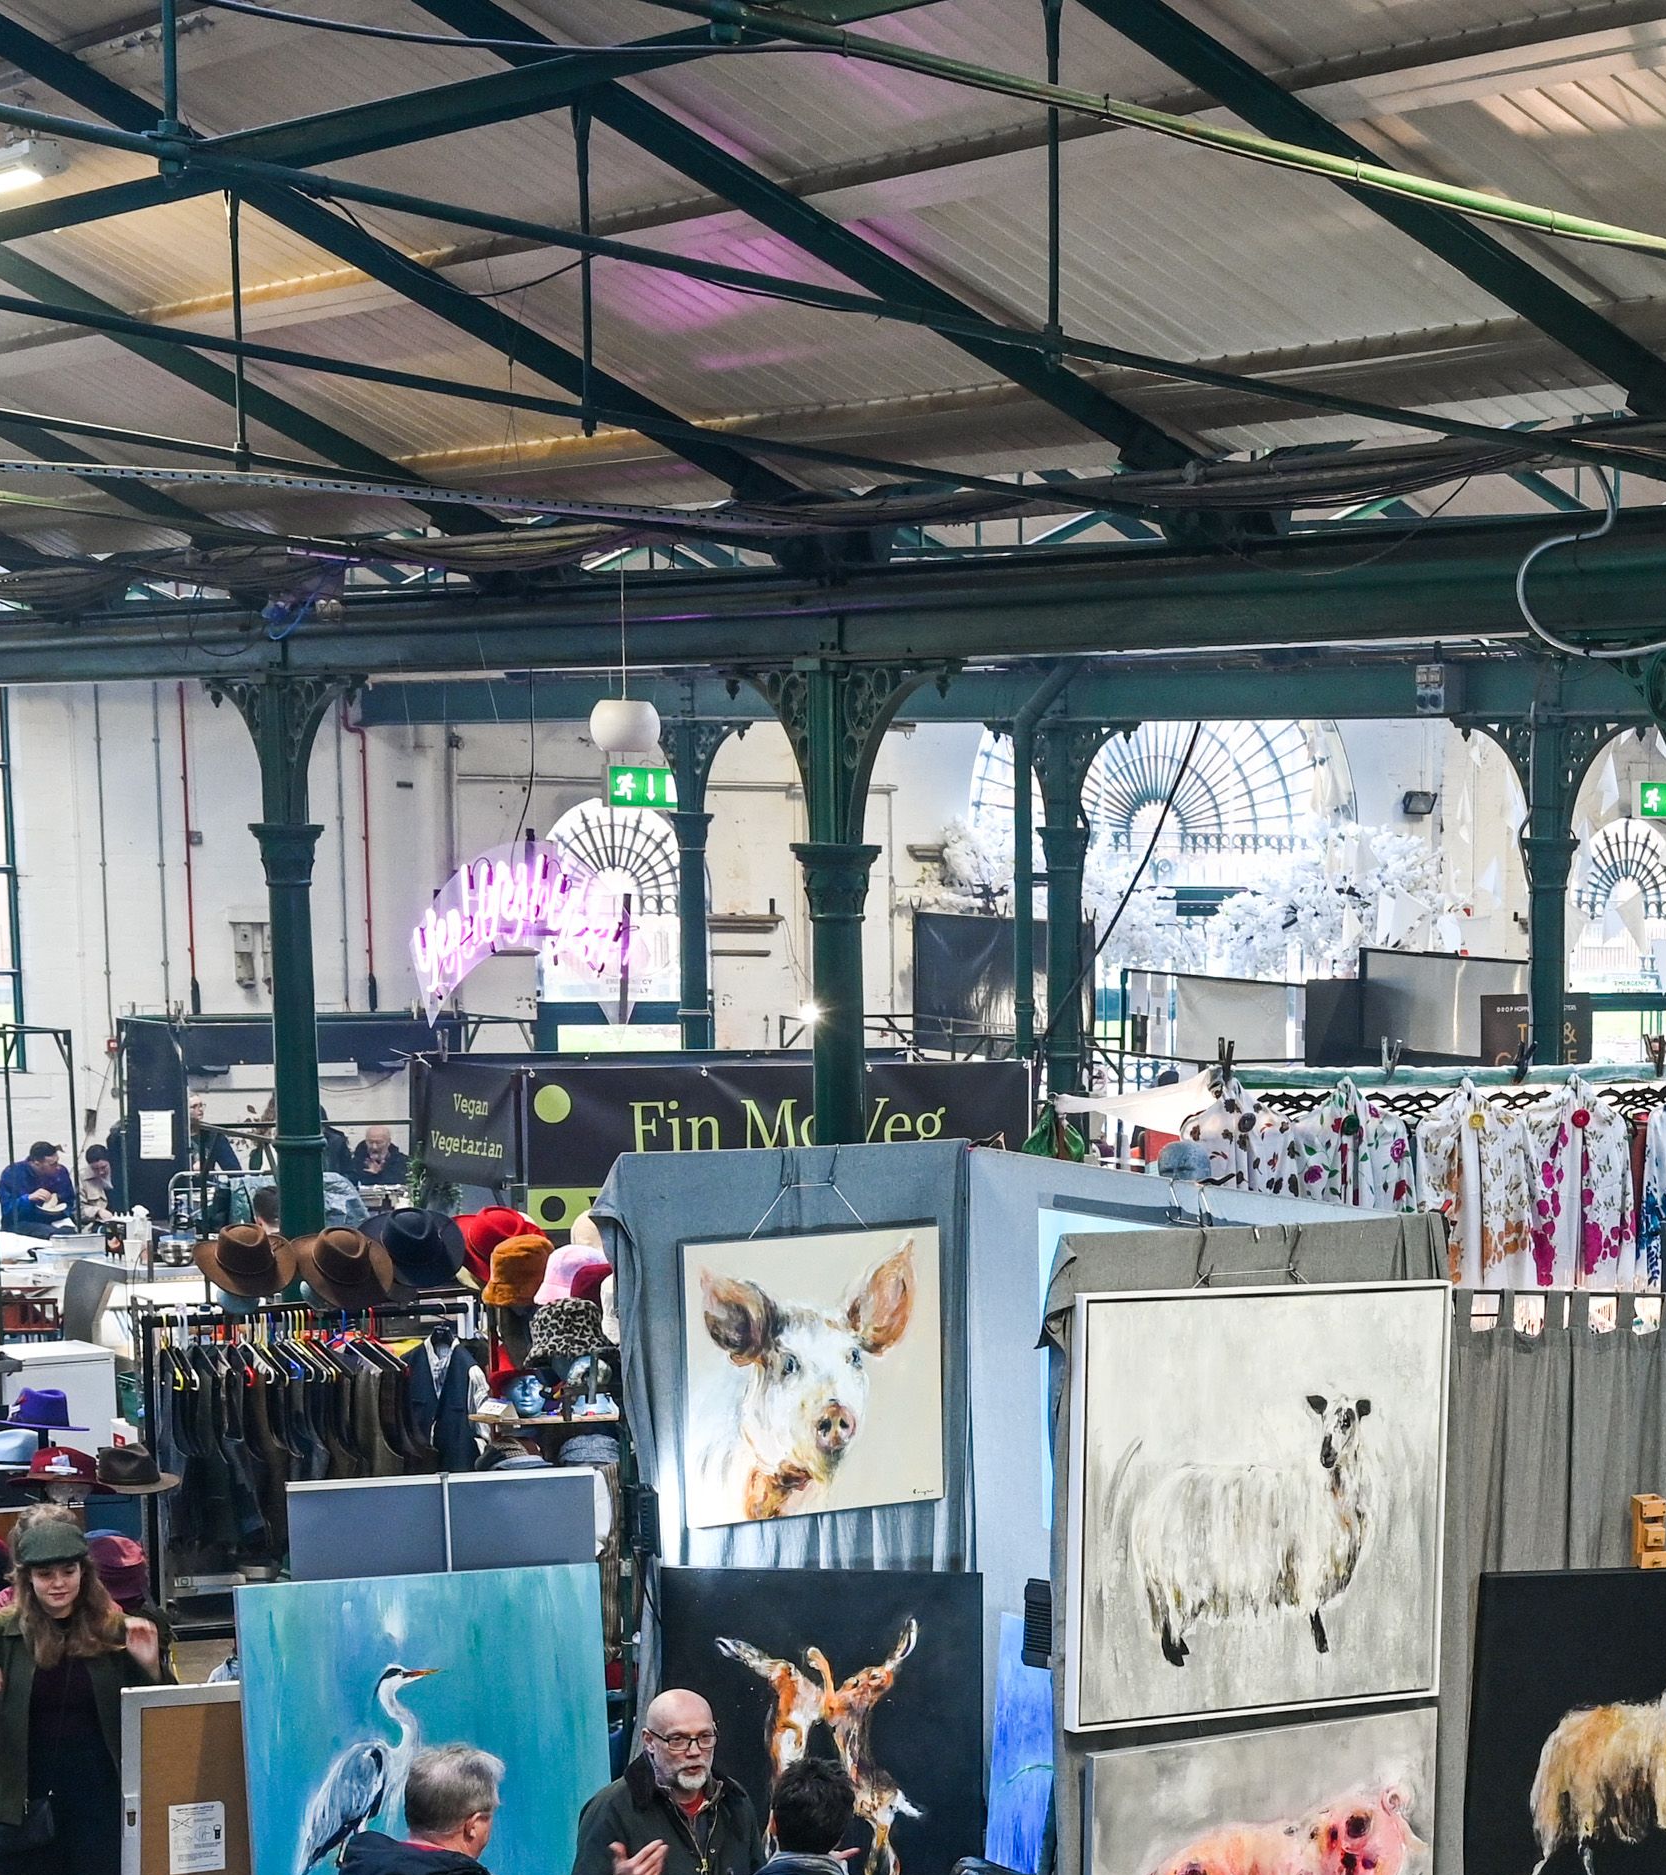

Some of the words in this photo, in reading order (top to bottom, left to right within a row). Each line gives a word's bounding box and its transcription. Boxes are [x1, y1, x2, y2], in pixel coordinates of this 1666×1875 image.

[452, 1092, 489, 1121] Vegan
[628, 1100, 720, 1153] Fin
[430, 1130, 504, 1159] Vegetarian
